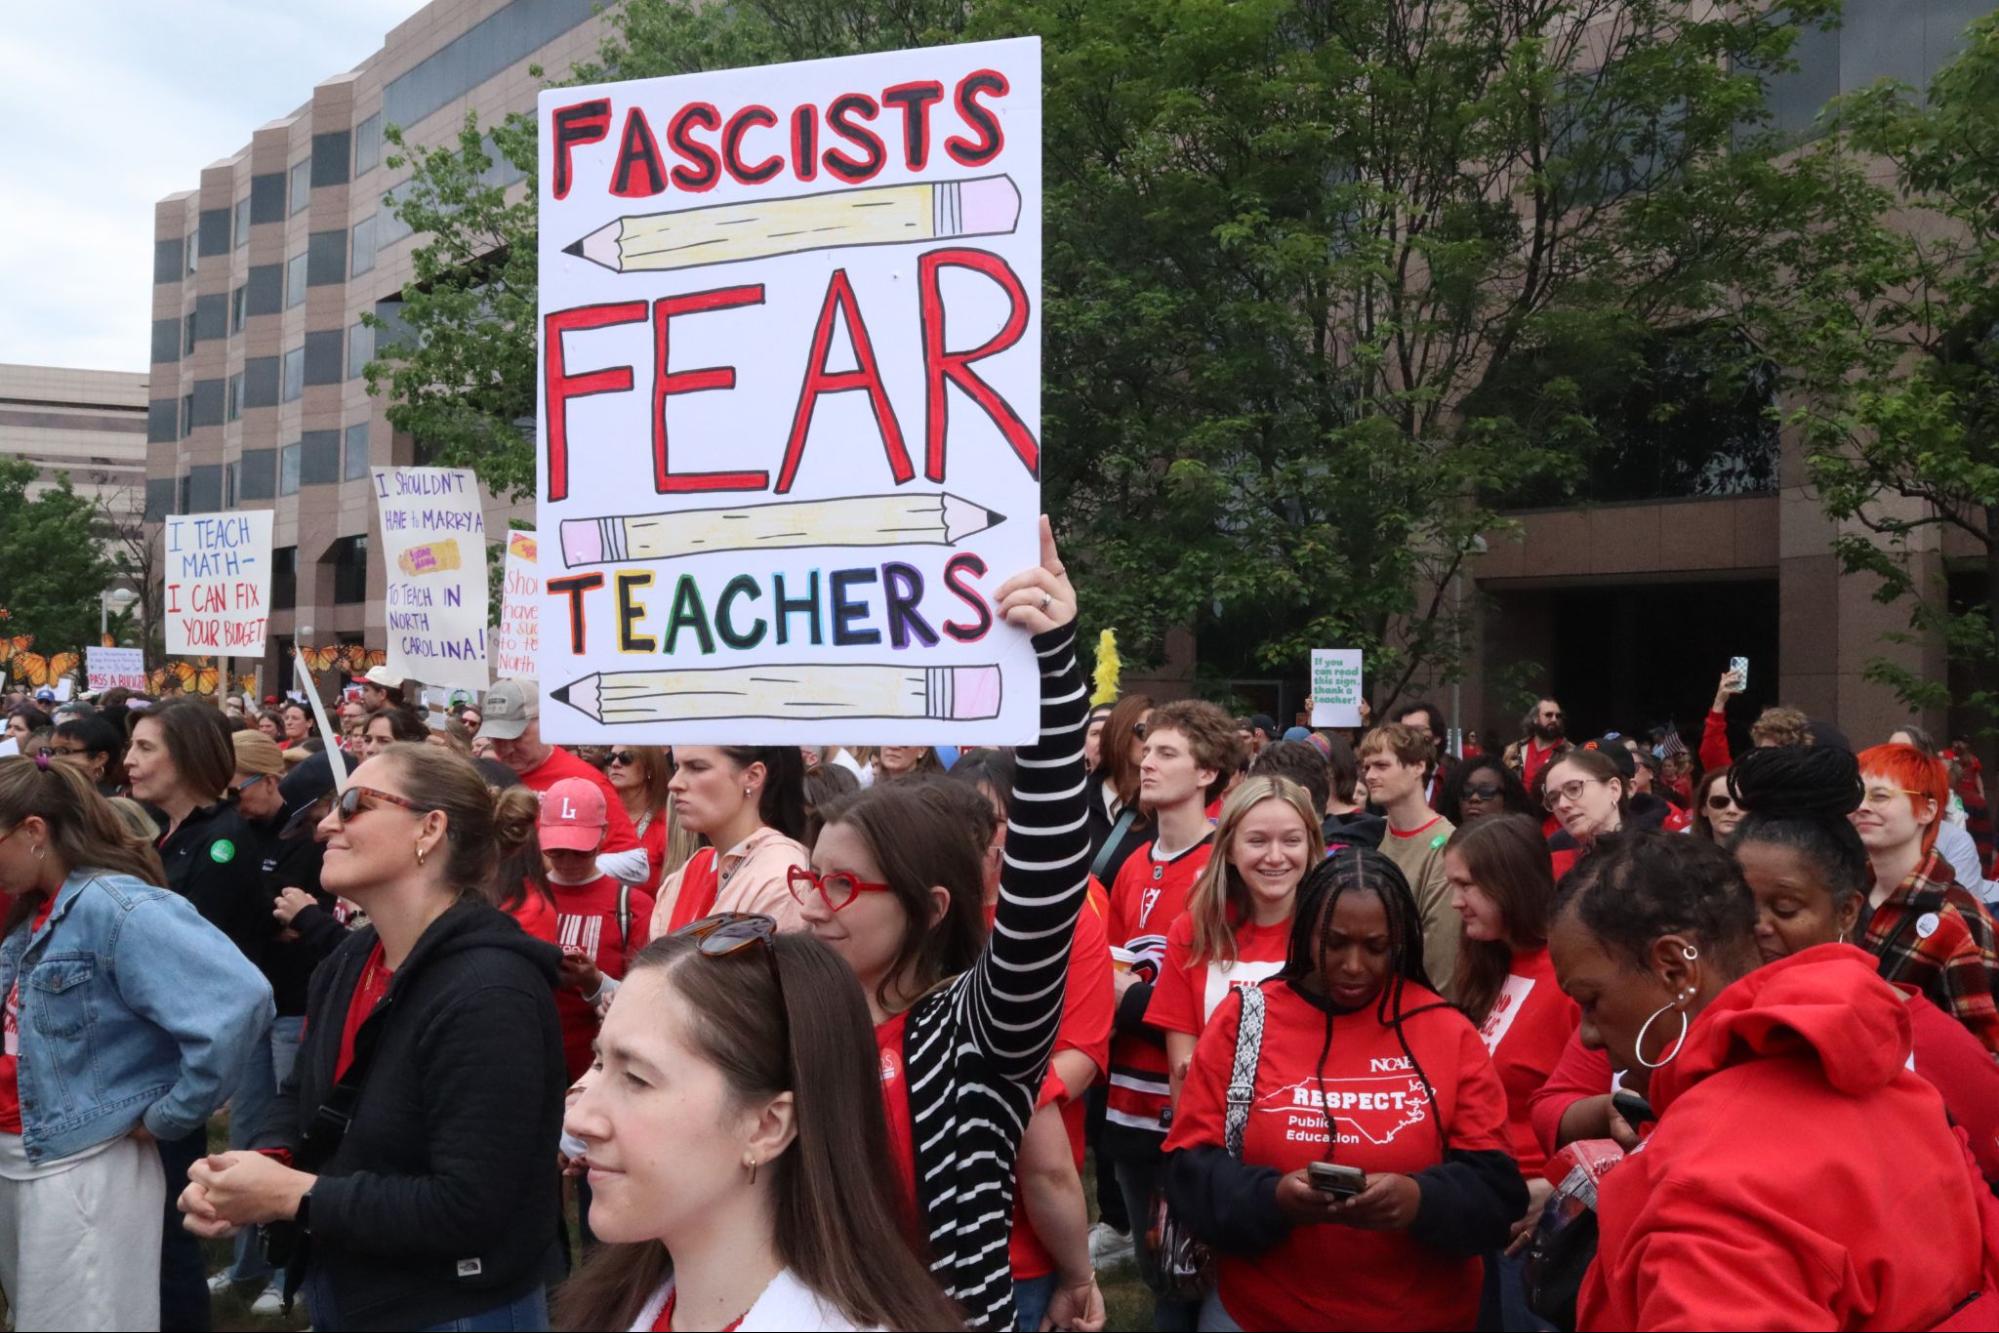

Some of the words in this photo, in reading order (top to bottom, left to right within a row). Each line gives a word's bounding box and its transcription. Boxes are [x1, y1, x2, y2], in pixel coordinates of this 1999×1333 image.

[552, 68, 1010, 200] FASCISTS
[544, 247, 1040, 502] FEAR
[375, 473, 390, 498] I
[395, 471, 465, 496] SHOULDN'T
[422, 509, 472, 532] MARRY
[475, 512, 484, 533] A
[168, 522, 184, 552] I
[194, 517, 250, 550] TEACH
[168, 584, 182, 613] I
[192, 583, 226, 613] CAN
[236, 583, 259, 609] FIX
[389, 584, 399, 606] TO
[401, 584, 433, 607] TEACH
[444, 584, 461, 607] IN
[547, 552, 993, 655] TEACHERS
[389, 611, 430, 631] NORTH
[183, 618, 219, 647] YOUR
[402, 628, 486, 660] CAROLINA!
[500, 637, 517, 651] to
[499, 653, 535, 673] North
[1314, 657, 1323, 665] If
[1324, 659, 1344, 668] you
[1335, 666, 1359, 675] read
[110, 673, 117, 687] A
[1314, 676, 1333, 685] this
[1314, 685, 1344, 694] thank
[1314, 696, 1357, 704] teacher!
[561, 797, 576, 819] L
[1292, 1087, 1406, 1110] RESPECT
[1286, 1130, 1360, 1144] Educaion
